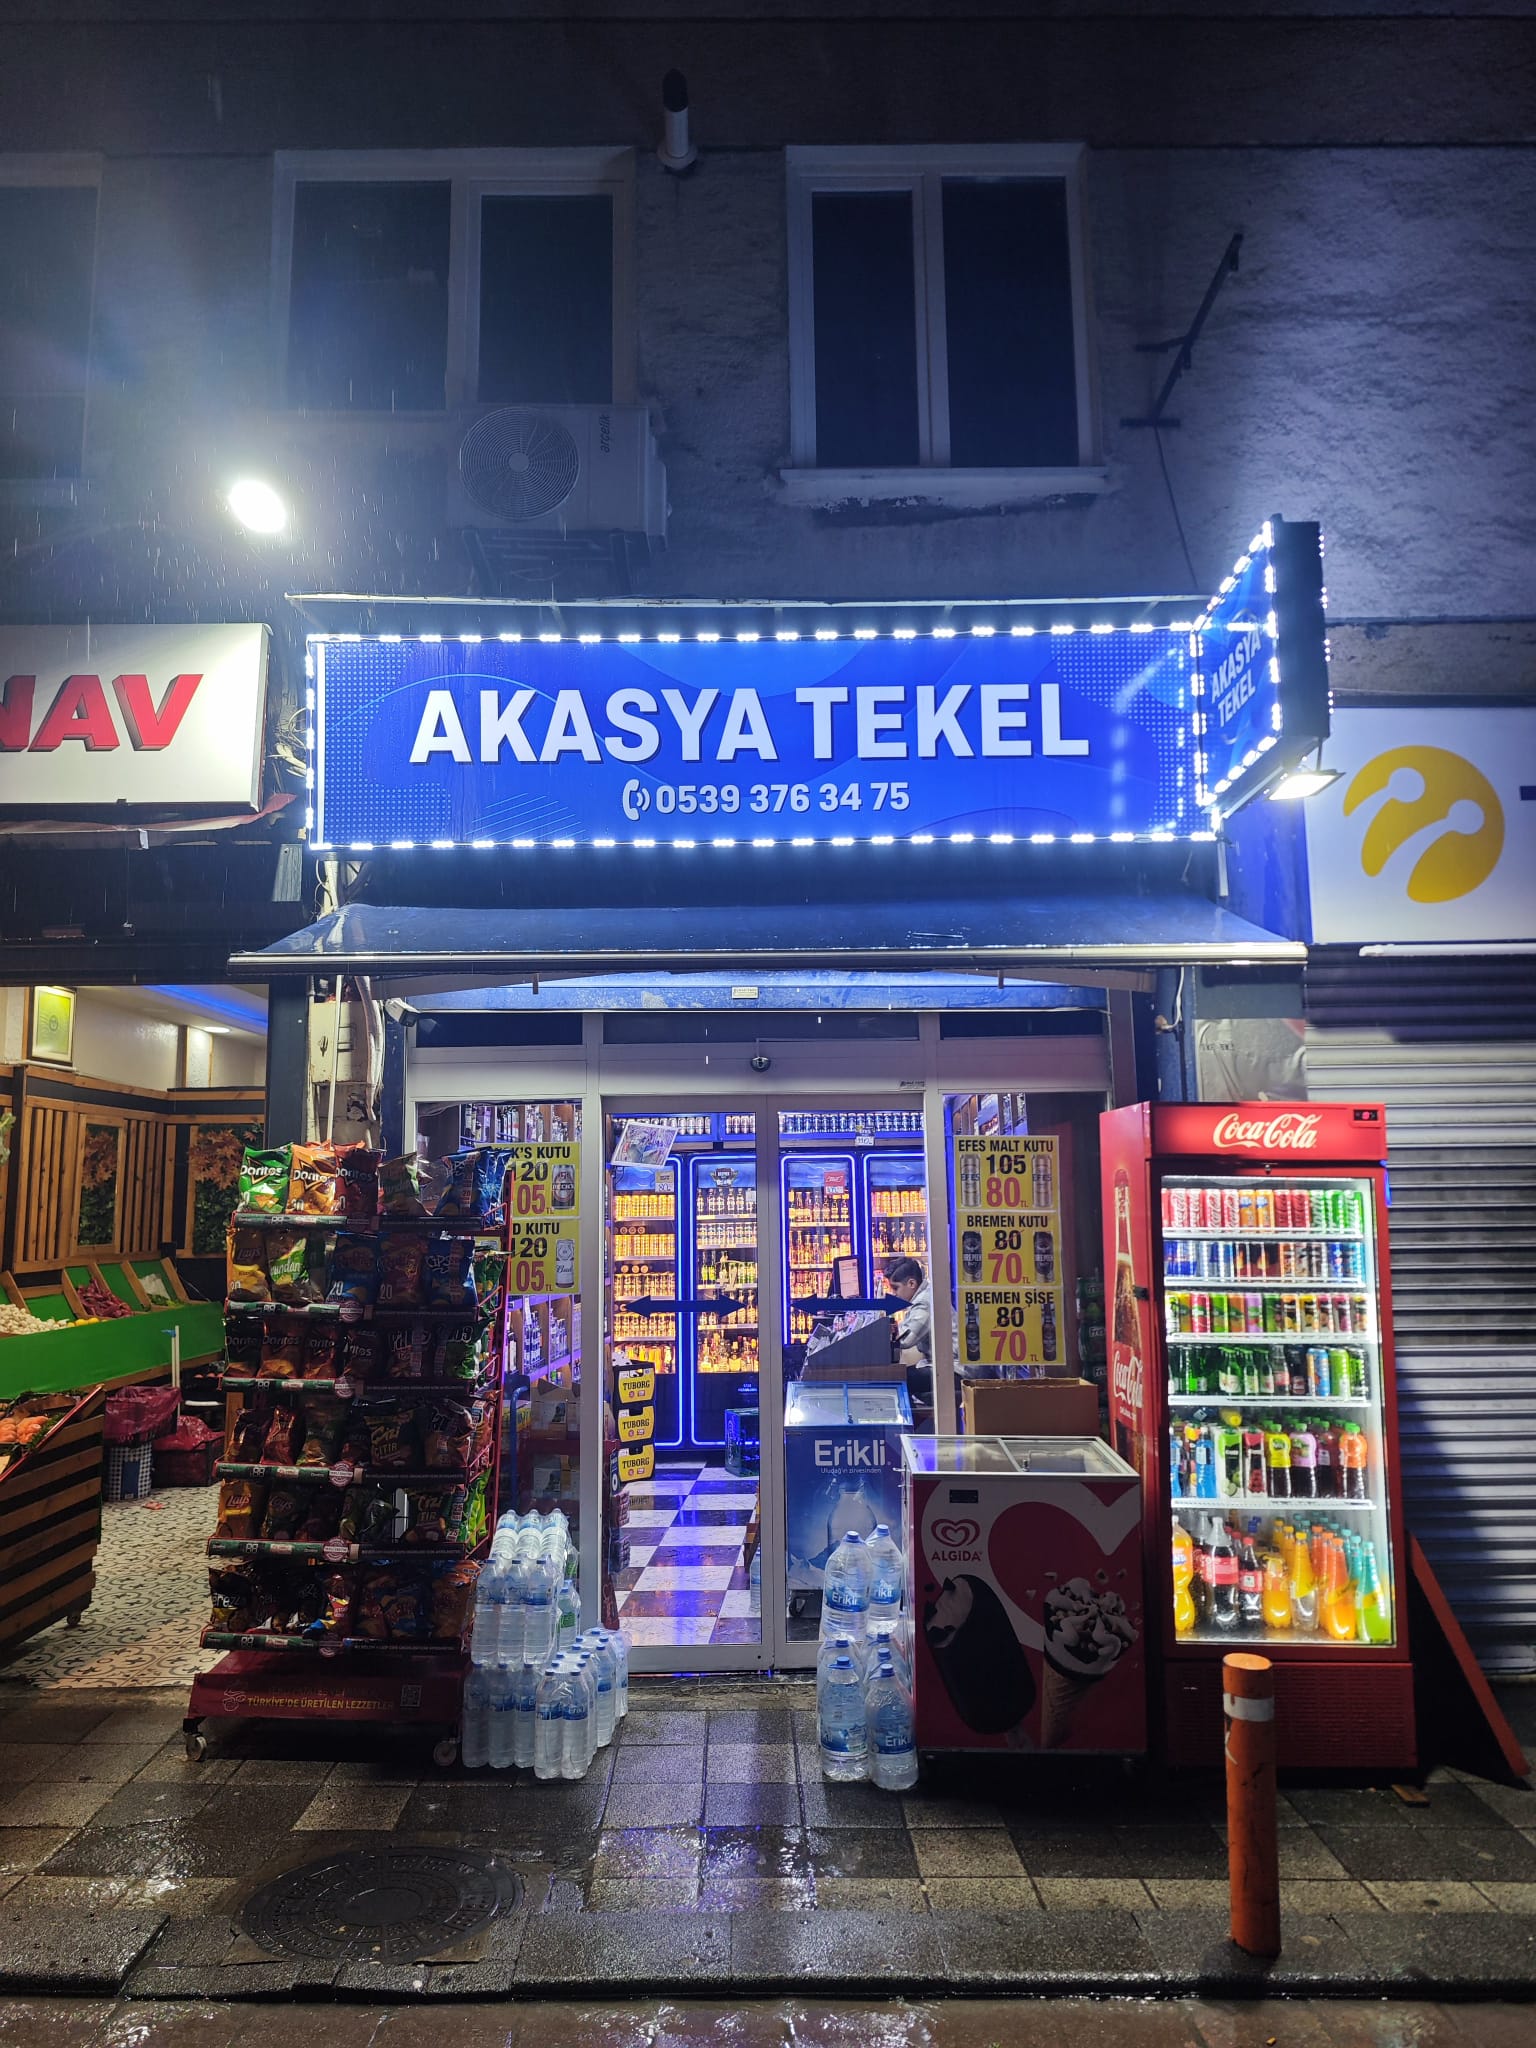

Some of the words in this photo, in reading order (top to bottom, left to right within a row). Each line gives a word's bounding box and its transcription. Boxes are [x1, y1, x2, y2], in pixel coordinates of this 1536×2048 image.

[1211, 627, 1262, 704] AKASYA
[1217, 668, 1256, 728] TEKEL
[409, 687, 779, 764] AKASYA
[795, 683, 1090, 760] TEKEL
[656, 783, 741, 815] 0539
[749, 783, 810, 814] 376
[818, 782, 861, 812] 34
[870, 781, 910, 811] 75
[1213, 1112, 1323, 1149] Coca-Cola
[537, 1146, 571, 1159] KUTU
[958, 1139, 986, 1152] EFES
[990, 1140, 1020, 1152] MALT
[1024, 1140, 1054, 1153] KUTU
[240, 1164, 283, 1177] Doritos
[986, 1154, 1027, 1175] 105
[960, 1173, 980, 1181] EFES
[986, 1176, 1021, 1208] 80
[1020, 1200, 1029, 1208] TL
[546, 1207, 555, 1215] TL
[526, 1222, 560, 1235] KUTU
[967, 1215, 1015, 1228] BREMEN
[1019, 1215, 1048, 1228] KUTU
[994, 1229, 1022, 1250] 80
[988, 1252, 1023, 1284] 70
[1022, 1276, 1031, 1284] TL
[380, 1283, 393, 1300] 20
[545, 1284, 553, 1292] TL
[965, 1291, 1021, 1304] BREMEN
[996, 1306, 1024, 1328] 80
[225, 1336, 258, 1346] Dorito
[990, 1330, 1027, 1362] 70
[1030, 1354, 1039, 1362] TL
[622, 1380, 650, 1391] TUBORG
[1113, 1350, 1143, 1409] Coca-Cola
[622, 1418, 650, 1430] TUBORG
[814, 1439, 886, 1467] Erikli
[622, 1457, 650, 1469] TUBORG
[831, 1591, 858, 1606] Erikli
[247, 1695, 300, 1708] TÜRKİYE'DE
[301, 1696, 344, 1710] ÜRETİLEN
